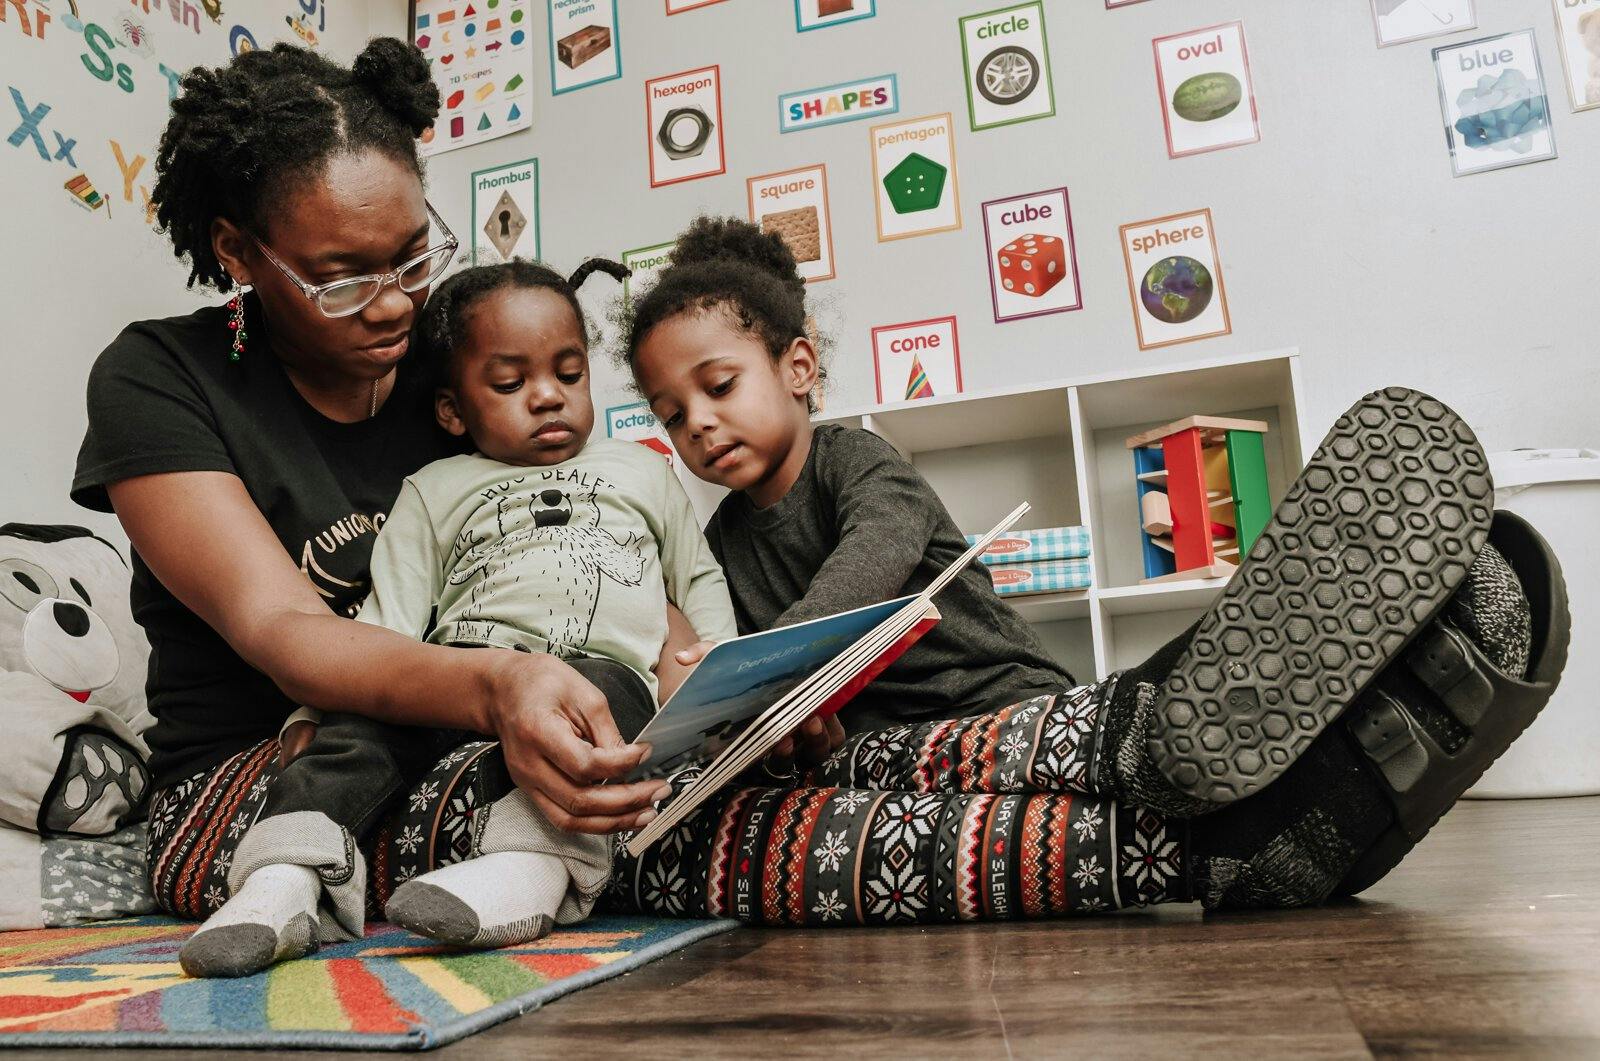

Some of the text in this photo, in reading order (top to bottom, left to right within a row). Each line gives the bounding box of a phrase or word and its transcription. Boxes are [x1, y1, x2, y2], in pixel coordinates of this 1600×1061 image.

[568, 4, 595, 19] prism
[976, 15, 1030, 40] circle
[80, 22, 135, 93] Ss
[1176, 35, 1223, 62] oval
[1458, 45, 1514, 73] blue
[653, 77, 712, 99] hexagon
[789, 87, 888, 122] SHAPES
[7, 86, 78, 168] Xx
[878, 124, 946, 150] pentagon
[478, 169, 532, 191] rhombus
[760, 177, 815, 200] square
[1000, 203, 1052, 226] cube
[1131, 223, 1205, 255] sphere
[890, 331, 941, 354] cone
[615, 414, 656, 429] octag
[481, 468, 616, 500] HU DEALE
[995, 800, 1015, 837] DAY
[742, 812, 764, 856] DAY
[169, 829, 197, 873] SLEIGH
[737, 878, 751, 919] SLEI
[991, 858, 1008, 914] SLEIGH
